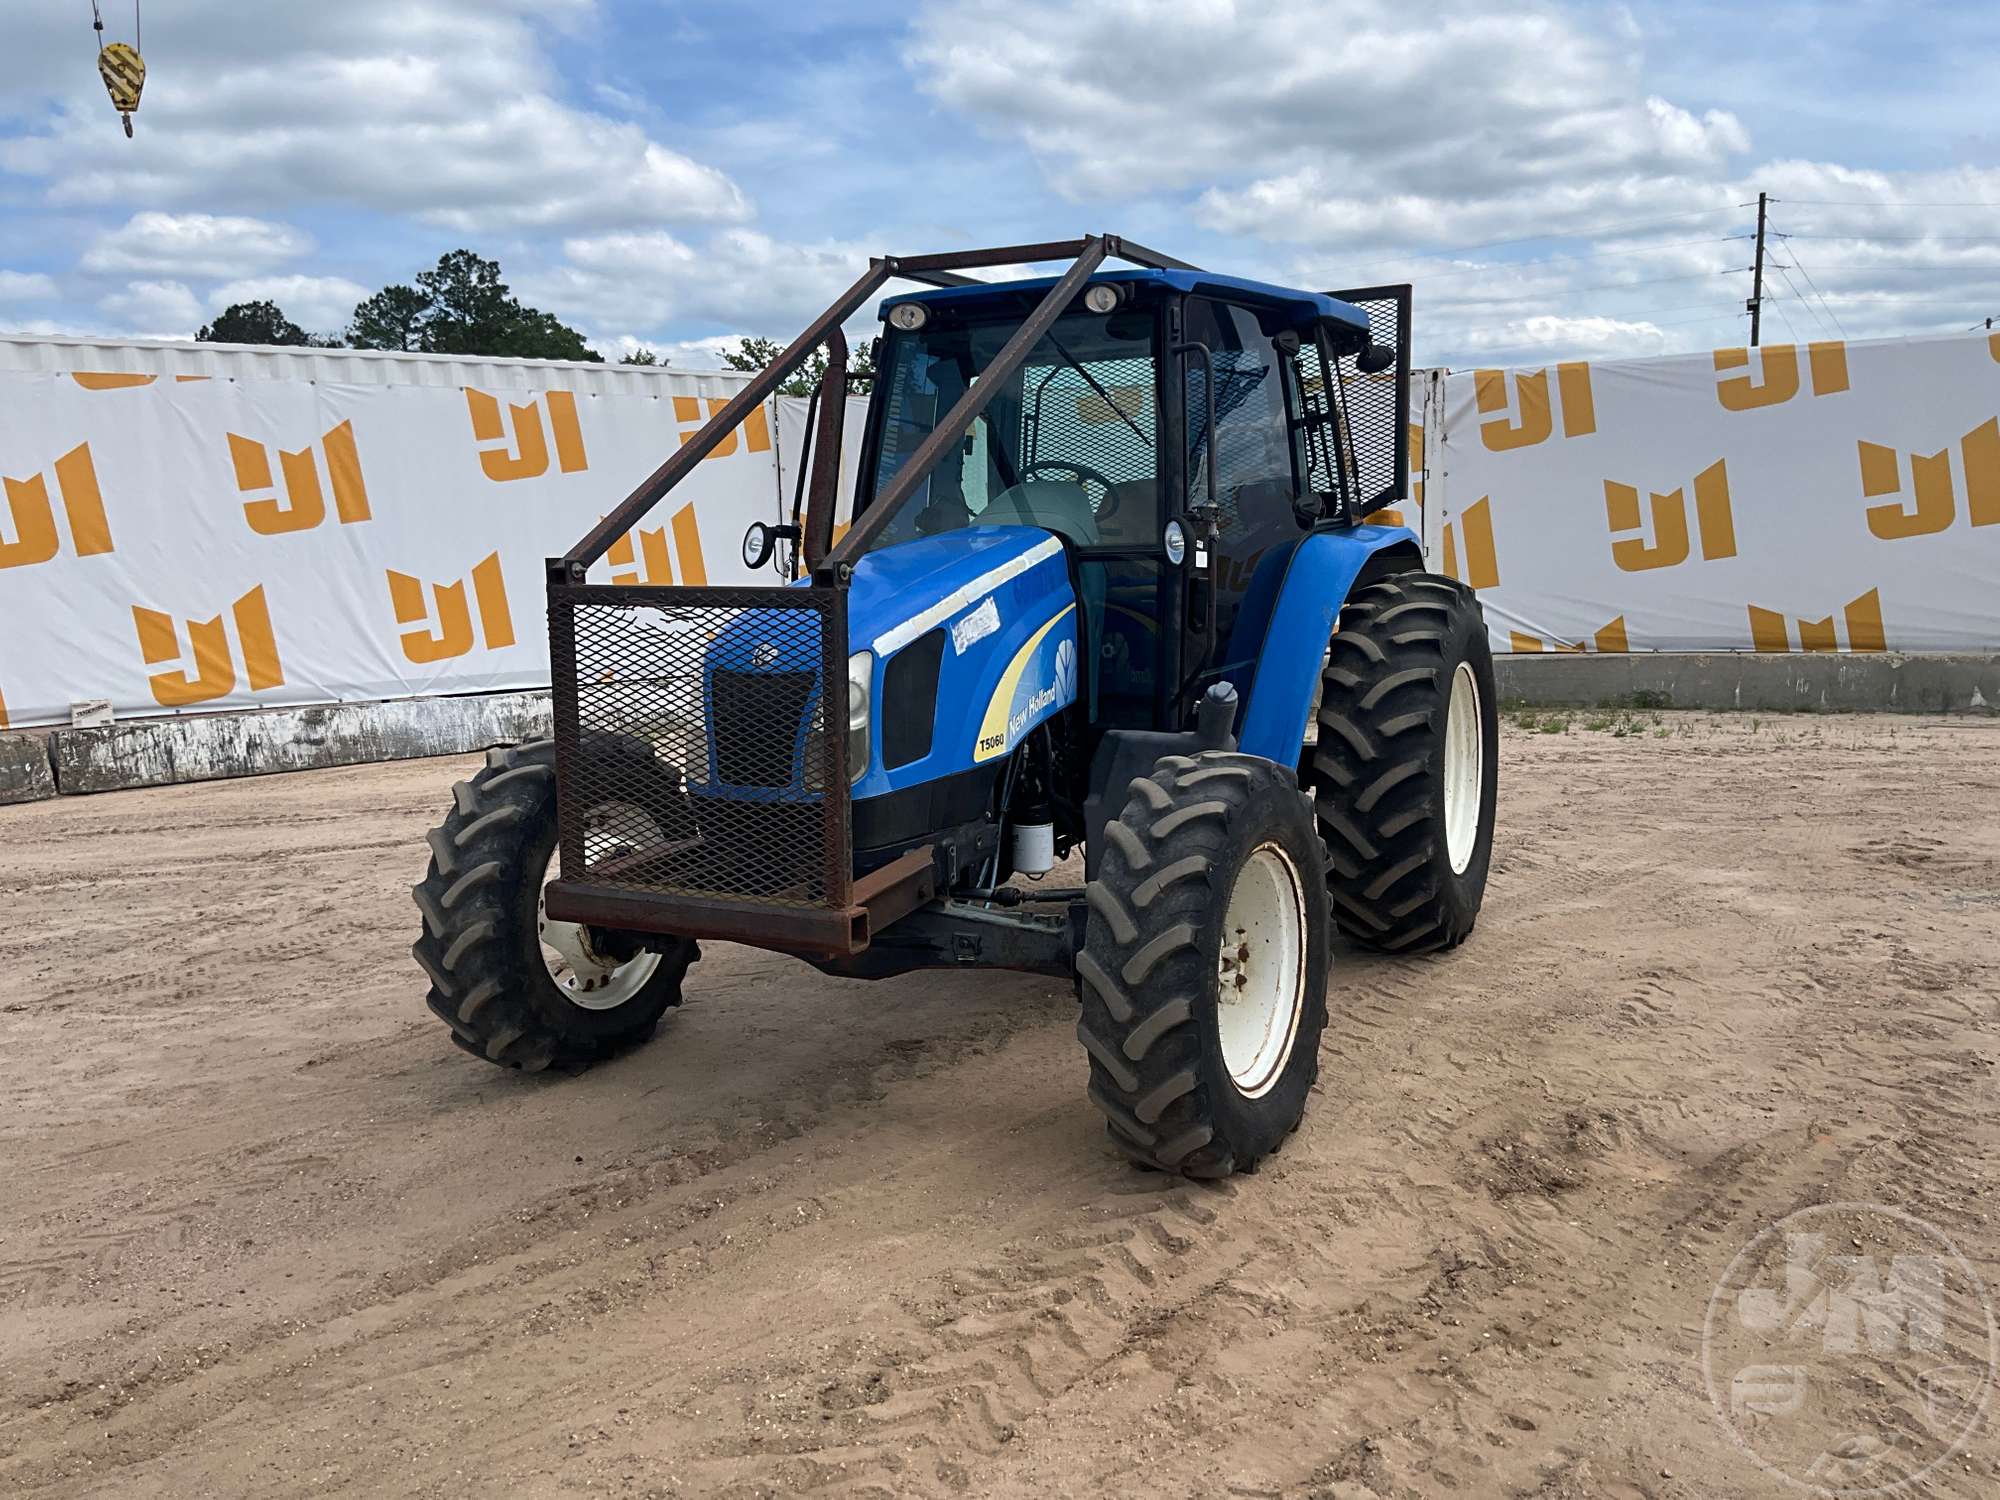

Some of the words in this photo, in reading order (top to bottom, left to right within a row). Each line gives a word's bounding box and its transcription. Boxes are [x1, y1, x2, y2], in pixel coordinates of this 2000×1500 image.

[1008, 708, 1028, 741] New
[1029, 681, 1056, 718] Holland
[979, 732, 1005, 753] T5060
